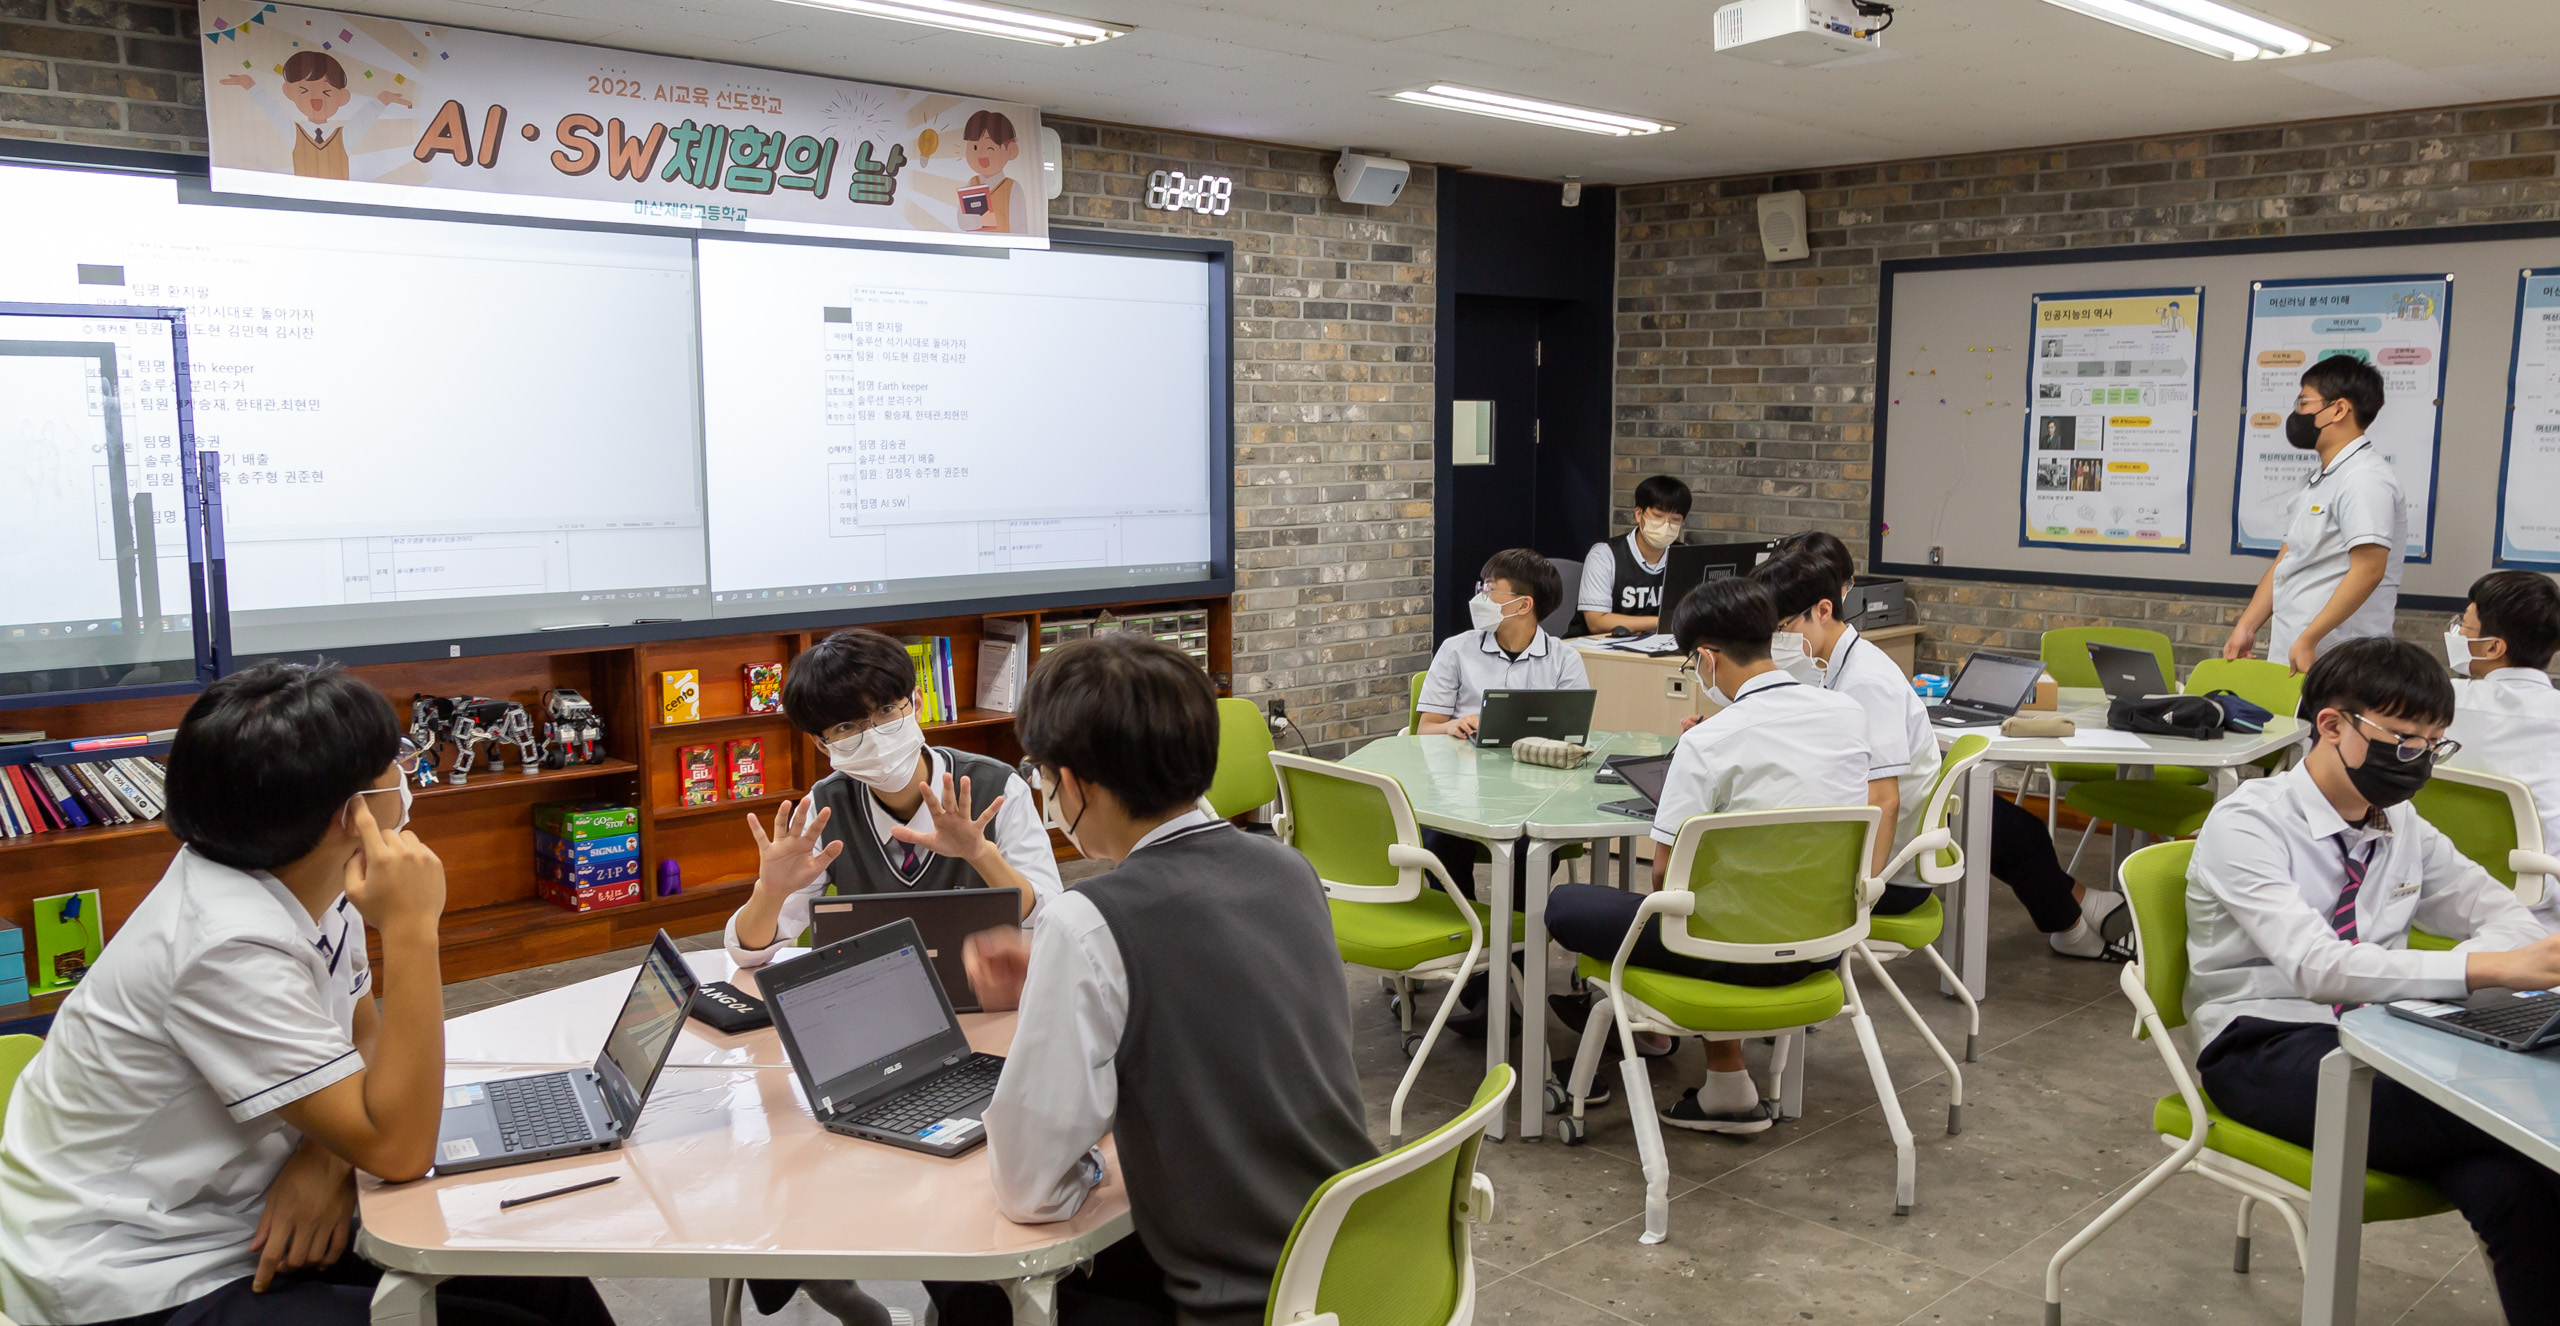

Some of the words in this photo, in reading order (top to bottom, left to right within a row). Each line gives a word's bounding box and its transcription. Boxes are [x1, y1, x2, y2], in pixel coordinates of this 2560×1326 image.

[587, 75, 646, 100] 2022.
[654, 83, 709, 107] AI교육
[716, 89, 782, 115] 선도학교
[413, 99, 508, 169] AI
[849, 141, 907, 206] 날
[634, 199, 748, 222] 마산제일고등학교
[132, 284, 160, 298] 팀명
[167, 285, 210, 300] 환지팔
[2269, 296, 2306, 308] 머신러닝
[2309, 295, 2328, 307] 분석
[2330, 294, 2350, 306] 이해
[261, 307, 315, 322] 돌아가자
[2043, 308, 2091, 321] 인공지능의
[2093, 307, 2113, 320] 역사
[135, 321, 163, 336] 팀원
[228, 324, 268, 339] 김민혁
[275, 325, 315, 340] 김시찬
[855, 321, 873, 332] 팀명
[855, 336, 882, 348] 솔루션
[886, 337, 930, 348] 석기시대로
[933, 338, 967, 350] 돌아가자
[856, 351, 874, 362] 팀원
[882, 351, 909, 362] 이도현
[912, 352, 938, 363] 김민혁
[941, 352, 966, 364] 김시찬
[138, 360, 166, 373] 팀명
[211, 362, 255, 375] keeper
[857, 380, 874, 391] 팀명
[878, 381, 899, 391] Earth
[902, 381, 929, 393] keeper
[141, 398, 169, 411] 팀원
[857, 395, 884, 406] 솔루션
[887, 395, 922, 406] 분리수거
[858, 410, 875, 421] 팀원
[143, 434, 171, 449] 팀명
[858, 439, 876, 450] 팀명
[880, 439, 906, 450] 김송권
[242, 453, 269, 466] 배출
[859, 453, 885, 465] 솔루션
[889, 453, 915, 465] 쓰레기
[918, 453, 936, 464] 배출
[146, 471, 174, 487] 팀원
[240, 471, 278, 485] 송주형
[284, 470, 324, 484] 권준현
[860, 468, 877, 480] 팀원
[915, 467, 940, 479] 송주형
[944, 466, 969, 478] 권준현
[860, 498, 877, 510] 팀명
[881, 499, 889, 508] AI
[892, 498, 906, 508] SW
[665, 687, 694, 712] cento
[593, 816, 607, 827] GO
[605, 820, 624, 830] STOP
[590, 845, 625, 857] SIGNAL
[699, 984, 754, 1014] ANGOL
[883, 1062, 903, 1076] ASUS
